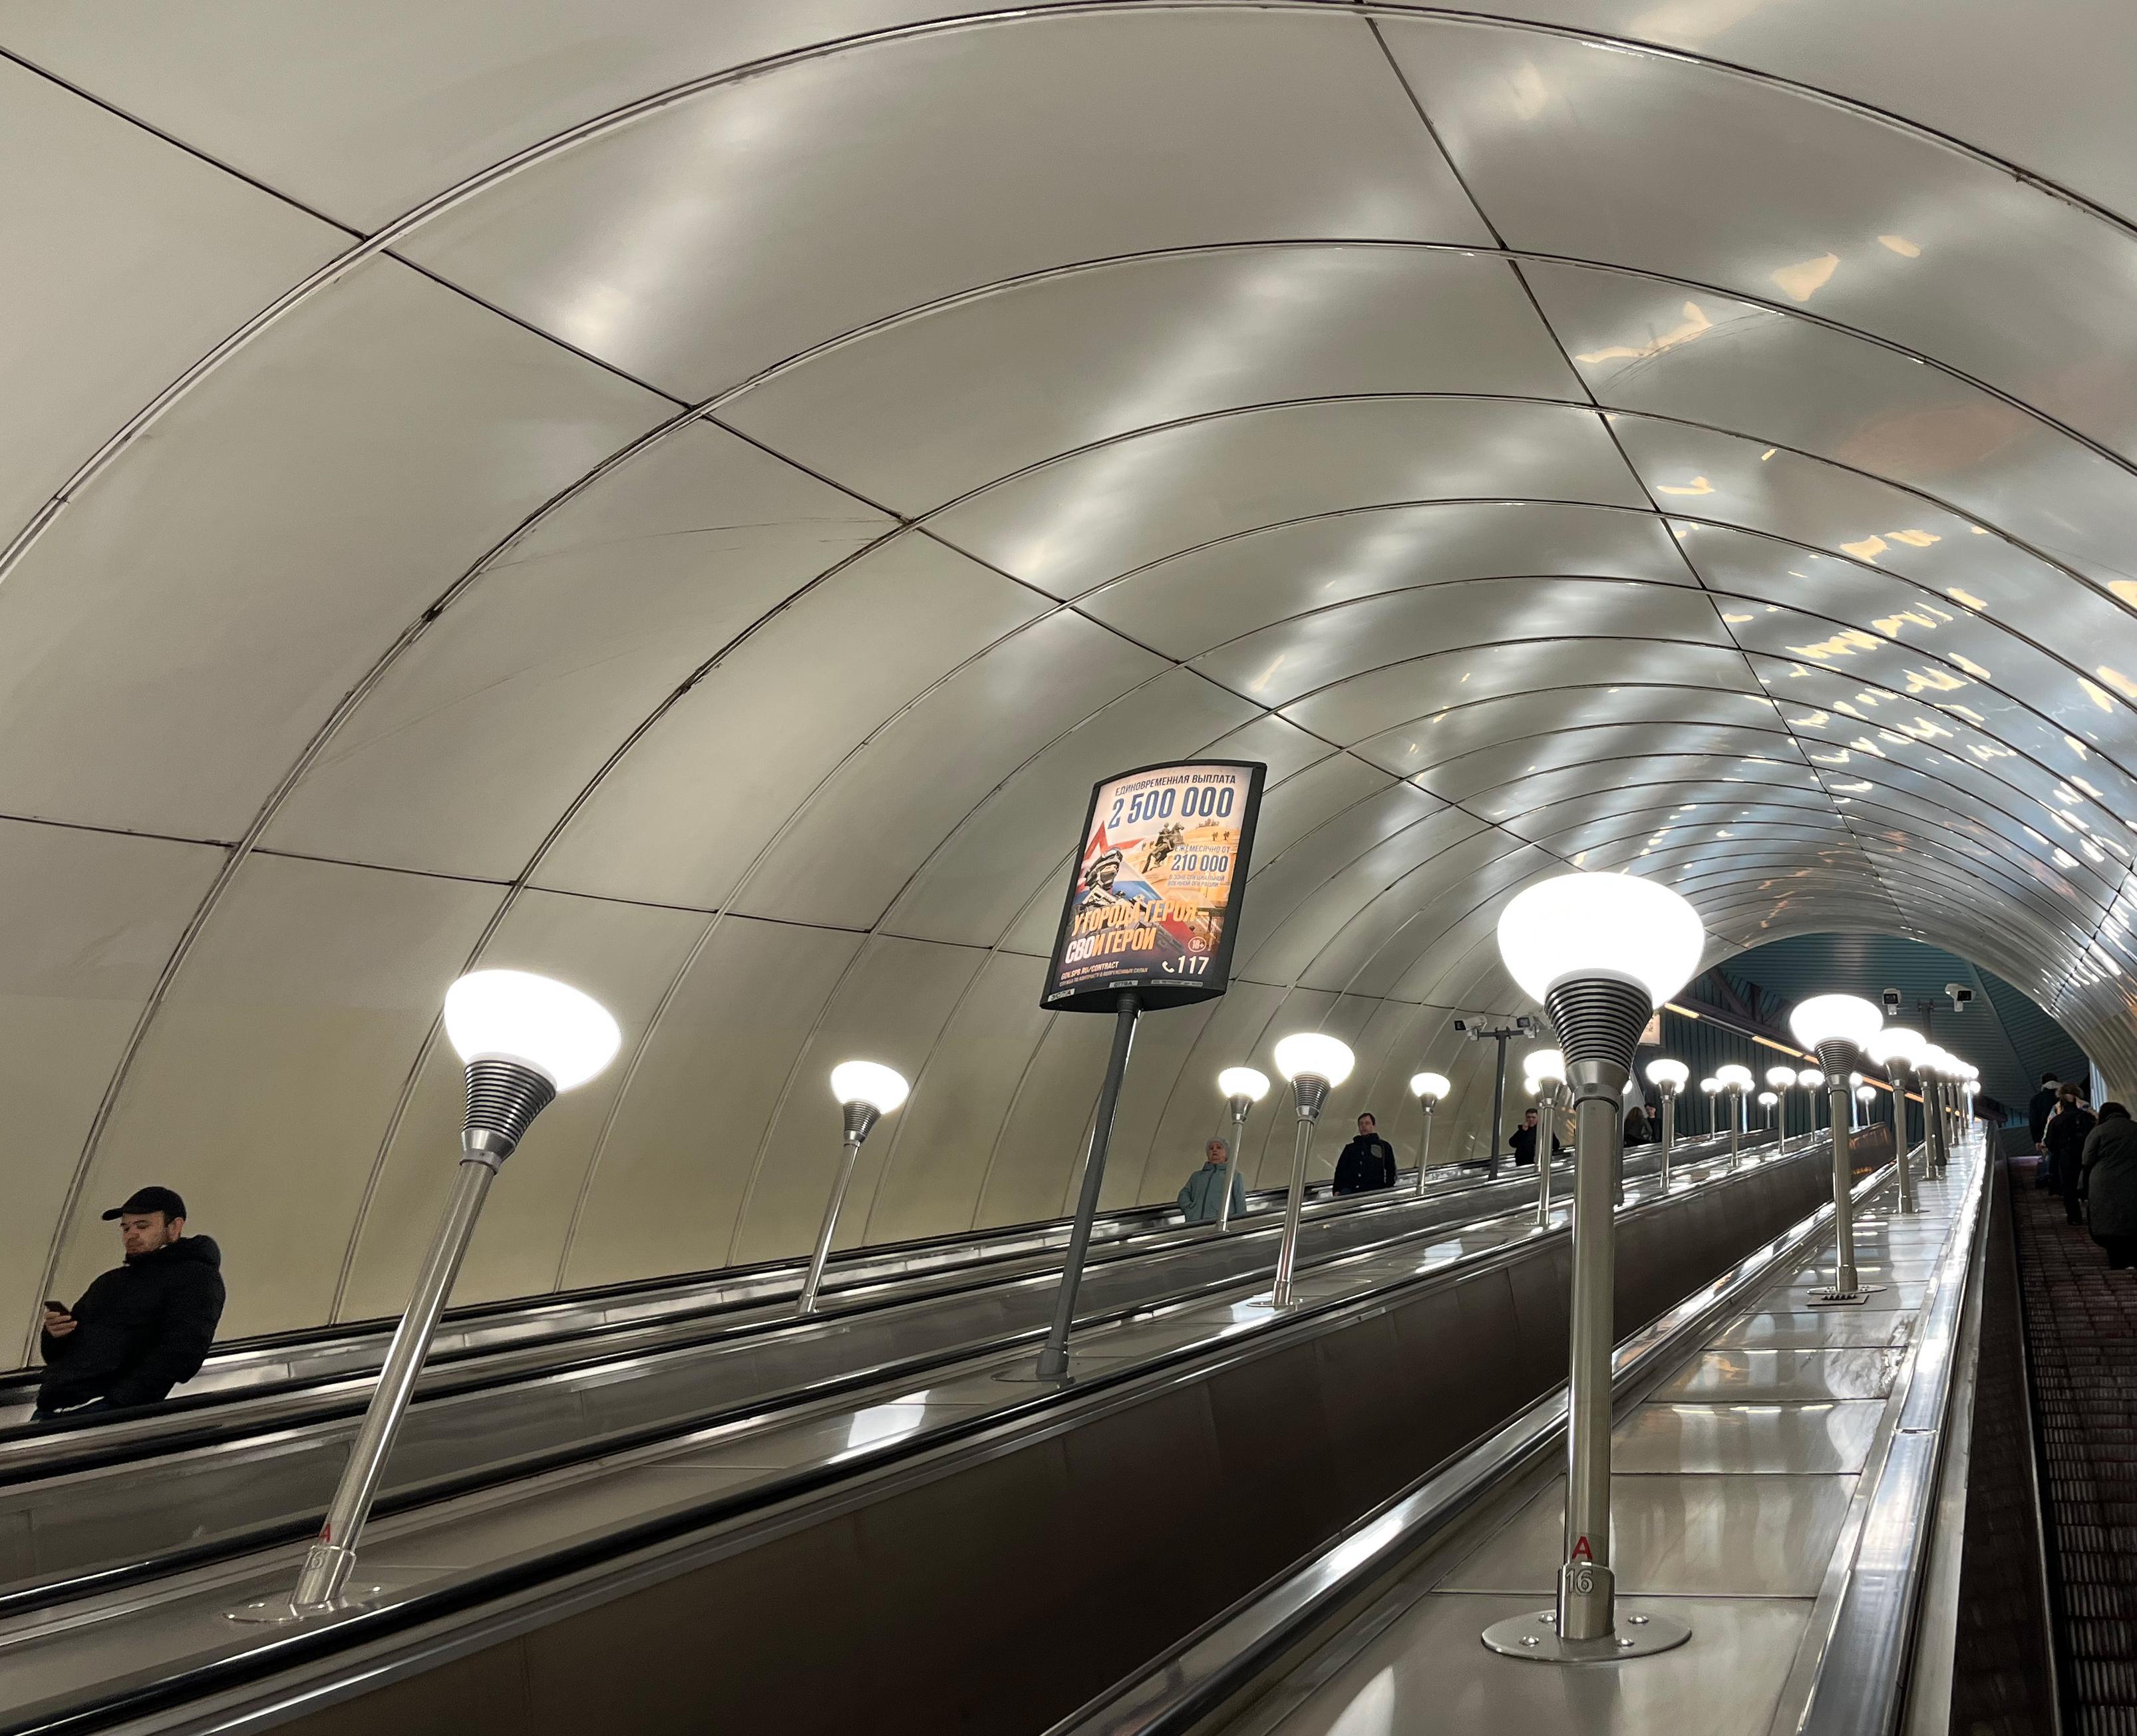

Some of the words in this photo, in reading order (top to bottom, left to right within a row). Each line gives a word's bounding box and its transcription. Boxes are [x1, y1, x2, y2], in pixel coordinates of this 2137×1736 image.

[1115, 775, 1190, 796] ЕДИНОВРЕМЕННАЯ
[1192, 775, 1236, 784] ВЫПЛАТА
[1107, 798, 1124, 830] 2
[1127, 788, 1176, 824] 500
[1181, 786, 1235, 818] 000
[1171, 854, 1198, 871] 210
[1200, 854, 1229, 872] 000
[1072, 914, 1084, 937] У
[1065, 933, 1106, 964] СВОИ
[1104, 927, 1157, 954] ГЕРОИ
[1191, 939, 1205, 950] 18+
[1178, 955, 1210, 975] 117
[1565, 1568, 1593, 1595] 16
